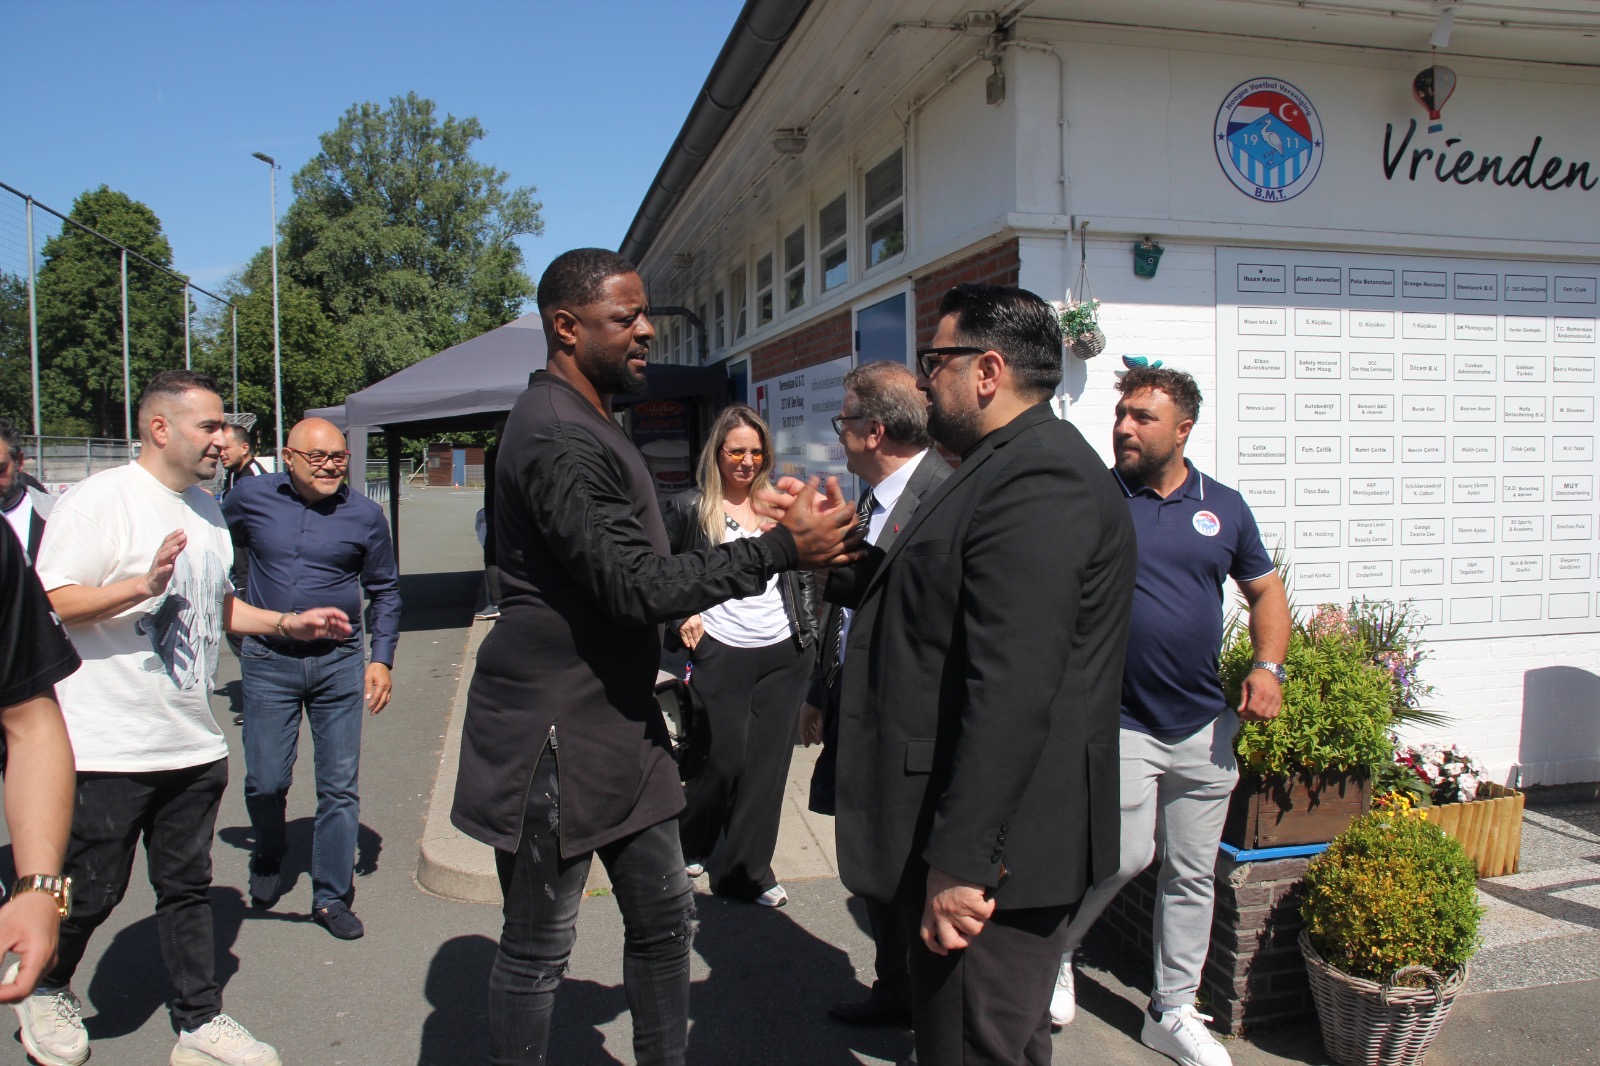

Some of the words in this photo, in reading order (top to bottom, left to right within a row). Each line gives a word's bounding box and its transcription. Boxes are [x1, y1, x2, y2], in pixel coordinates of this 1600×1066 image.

[1226, 88, 1248, 110] Haagse
[1249, 81, 1277, 91] Voetbal
[1279, 84, 1312, 117] Vereniging
[1243, 134, 1258, 145] 19
[1286, 137, 1299, 148] 11
[1383, 118, 1599, 191] Vrienden
[1255, 188, 1287, 200] B.M.T.
